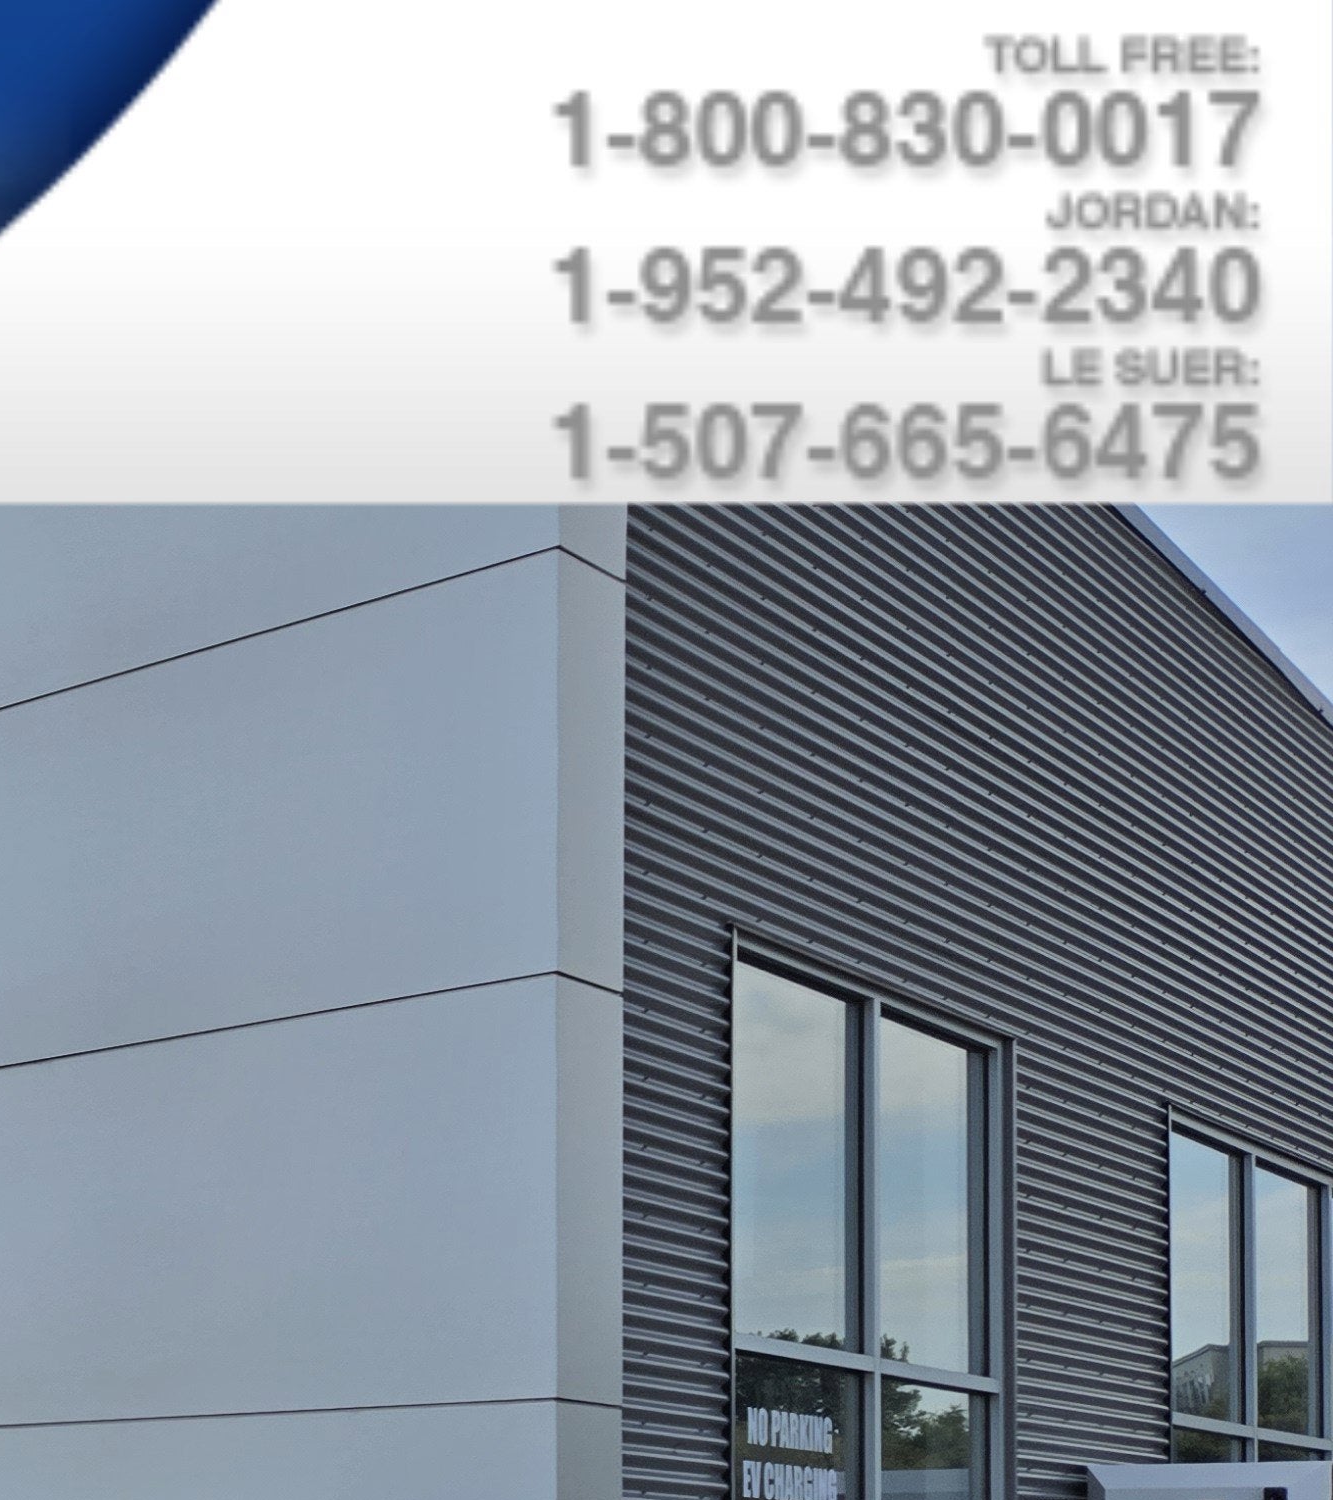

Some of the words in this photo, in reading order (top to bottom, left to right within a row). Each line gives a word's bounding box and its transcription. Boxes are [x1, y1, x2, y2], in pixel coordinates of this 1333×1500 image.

[747, 1407, 768, 1446] NO
[771, 1410, 833, 1454] PARKING
[742, 1460, 762, 1498] EV
